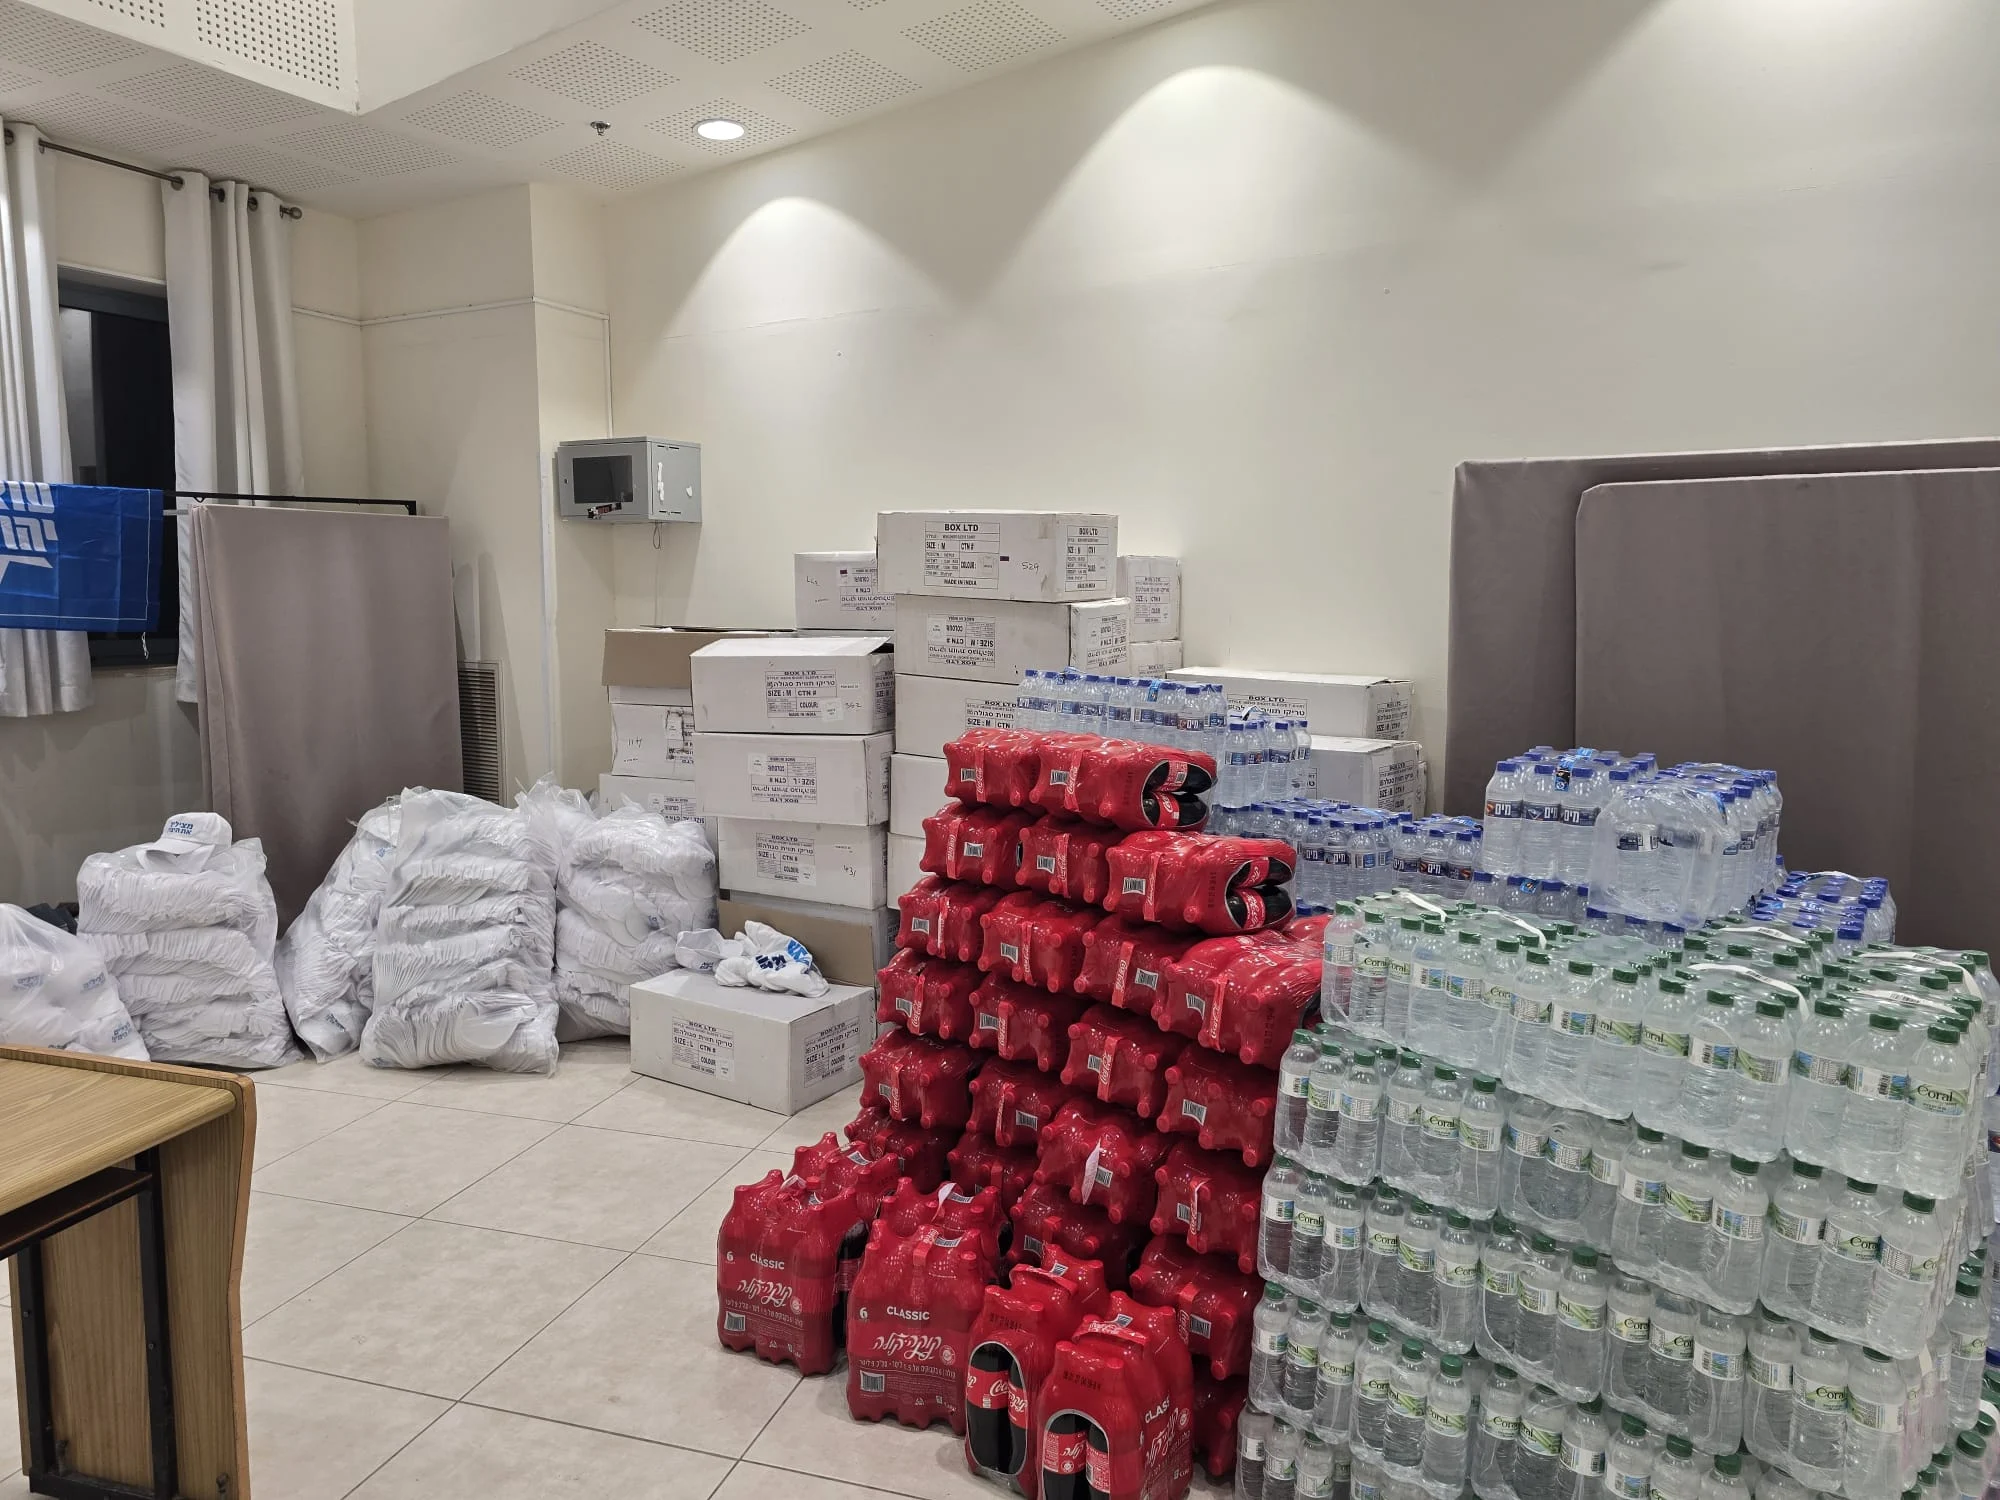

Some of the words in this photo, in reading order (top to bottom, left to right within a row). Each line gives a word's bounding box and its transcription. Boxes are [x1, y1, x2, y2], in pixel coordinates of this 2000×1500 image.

[945, 523, 960, 532] BOX
[964, 524, 979, 532] LTD
[961, 542, 970, 550] CTN
[674, 1036, 686, 1046] SIZE
[830, 1045, 840, 1053] CTN
[806, 1054, 817, 1064] SIZE
[1918, 1084, 1953, 1102] Coral
[1430, 1116, 1455, 1128] Coral
[1299, 1212, 1323, 1226] Coral
[1850, 1236, 1877, 1250] Cora
[727, 1251, 734, 1262] 6
[750, 1253, 785, 1270] CLASSIC
[860, 1307, 868, 1319] 6
[887, 1306, 930, 1320] CLASSIC
[1816, 1386, 1844, 1399] Cora
